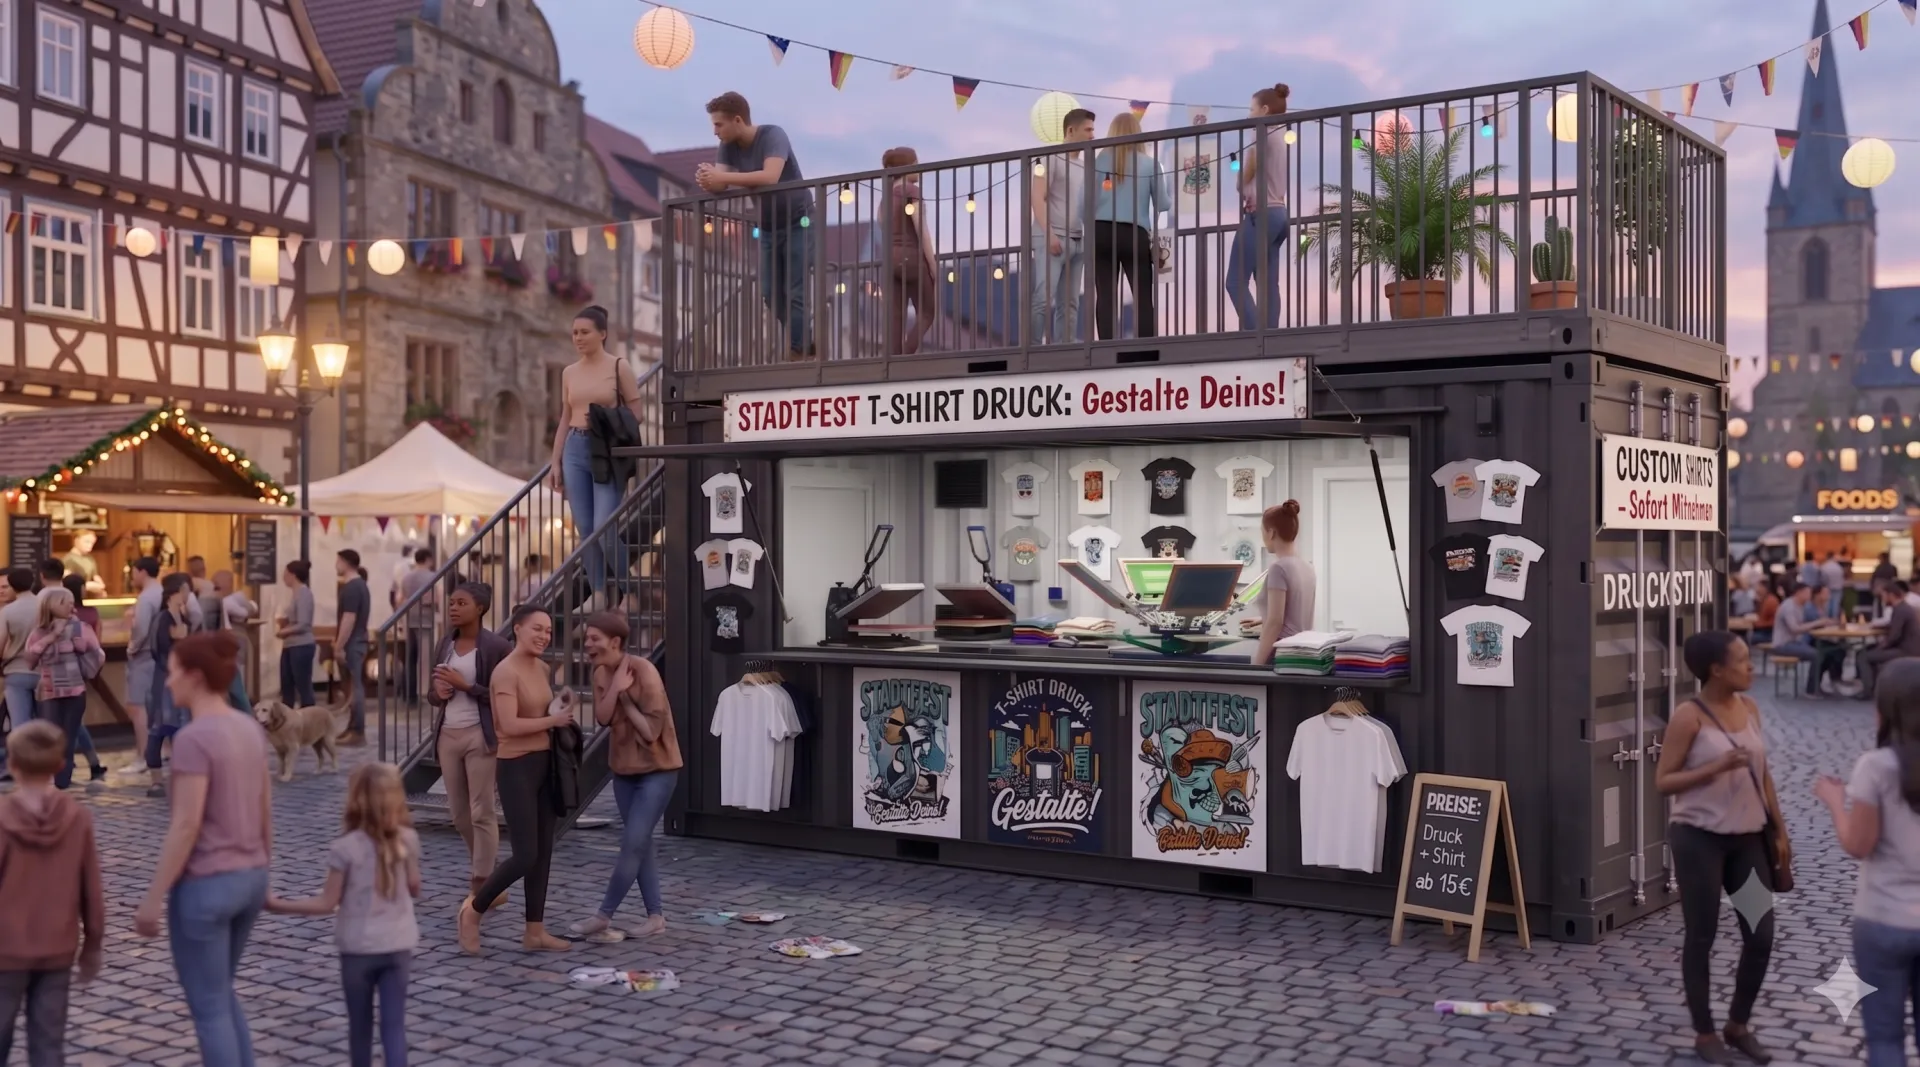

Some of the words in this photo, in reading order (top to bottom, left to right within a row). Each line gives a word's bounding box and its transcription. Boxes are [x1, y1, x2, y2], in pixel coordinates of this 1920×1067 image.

[738, 396, 860, 432] STADTFEST
[868, 389, 964, 425] T-SHIRT
[972, 383, 1073, 421] DRUCK:
[1081, 378, 1190, 416] Gestalte
[1200, 371, 1286, 410] Deins!
[1616, 446, 1682, 484] CUSTOM
[1686, 454, 1713, 488] SHIRTS
[1629, 489, 1668, 520] Sofort
[1816, 488, 1899, 511] FOODS
[860, 678, 952, 726] STADTFEST
[994, 678, 1045, 716] T-SHIRT
[1139, 691, 1258, 739] STADTFEST
[991, 787, 1103, 831] Gestalte!
[1426, 792, 1482, 815] PREISE:
[1423, 824, 1463, 845] Druck
[1419, 849, 1430, 860] +
[1432, 847, 1466, 868] Shirt
[1415, 872, 1434, 891] ab
[1439, 873, 1473, 897] 15€
